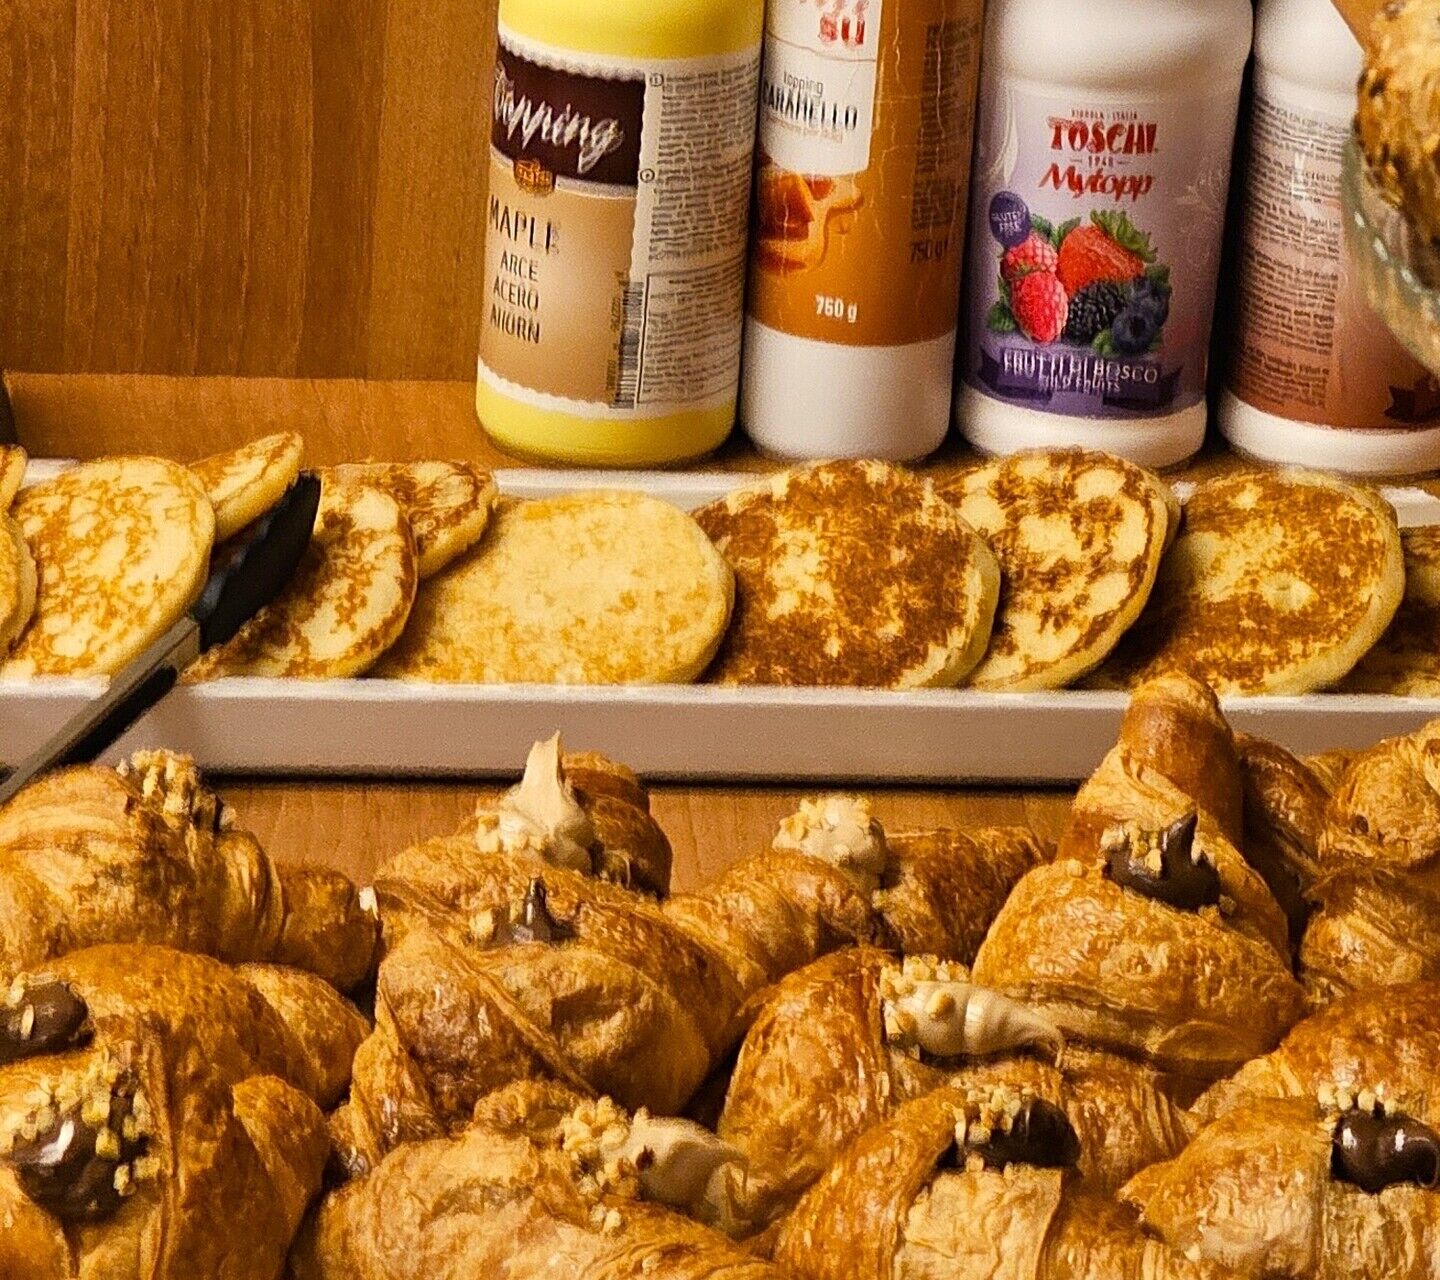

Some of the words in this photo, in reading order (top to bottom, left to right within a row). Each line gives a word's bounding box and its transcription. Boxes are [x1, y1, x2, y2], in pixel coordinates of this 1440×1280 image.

[1046, 116, 1157, 154] TOSCHI
[1039, 163, 1153, 202] Mytopp
[490, 195, 560, 255] MAPLE
[500, 250, 539, 282] ARCE
[493, 276, 539, 313] ACERO
[490, 303, 540, 345] AHORN
[1094, 358, 1158, 384] BOSCO
